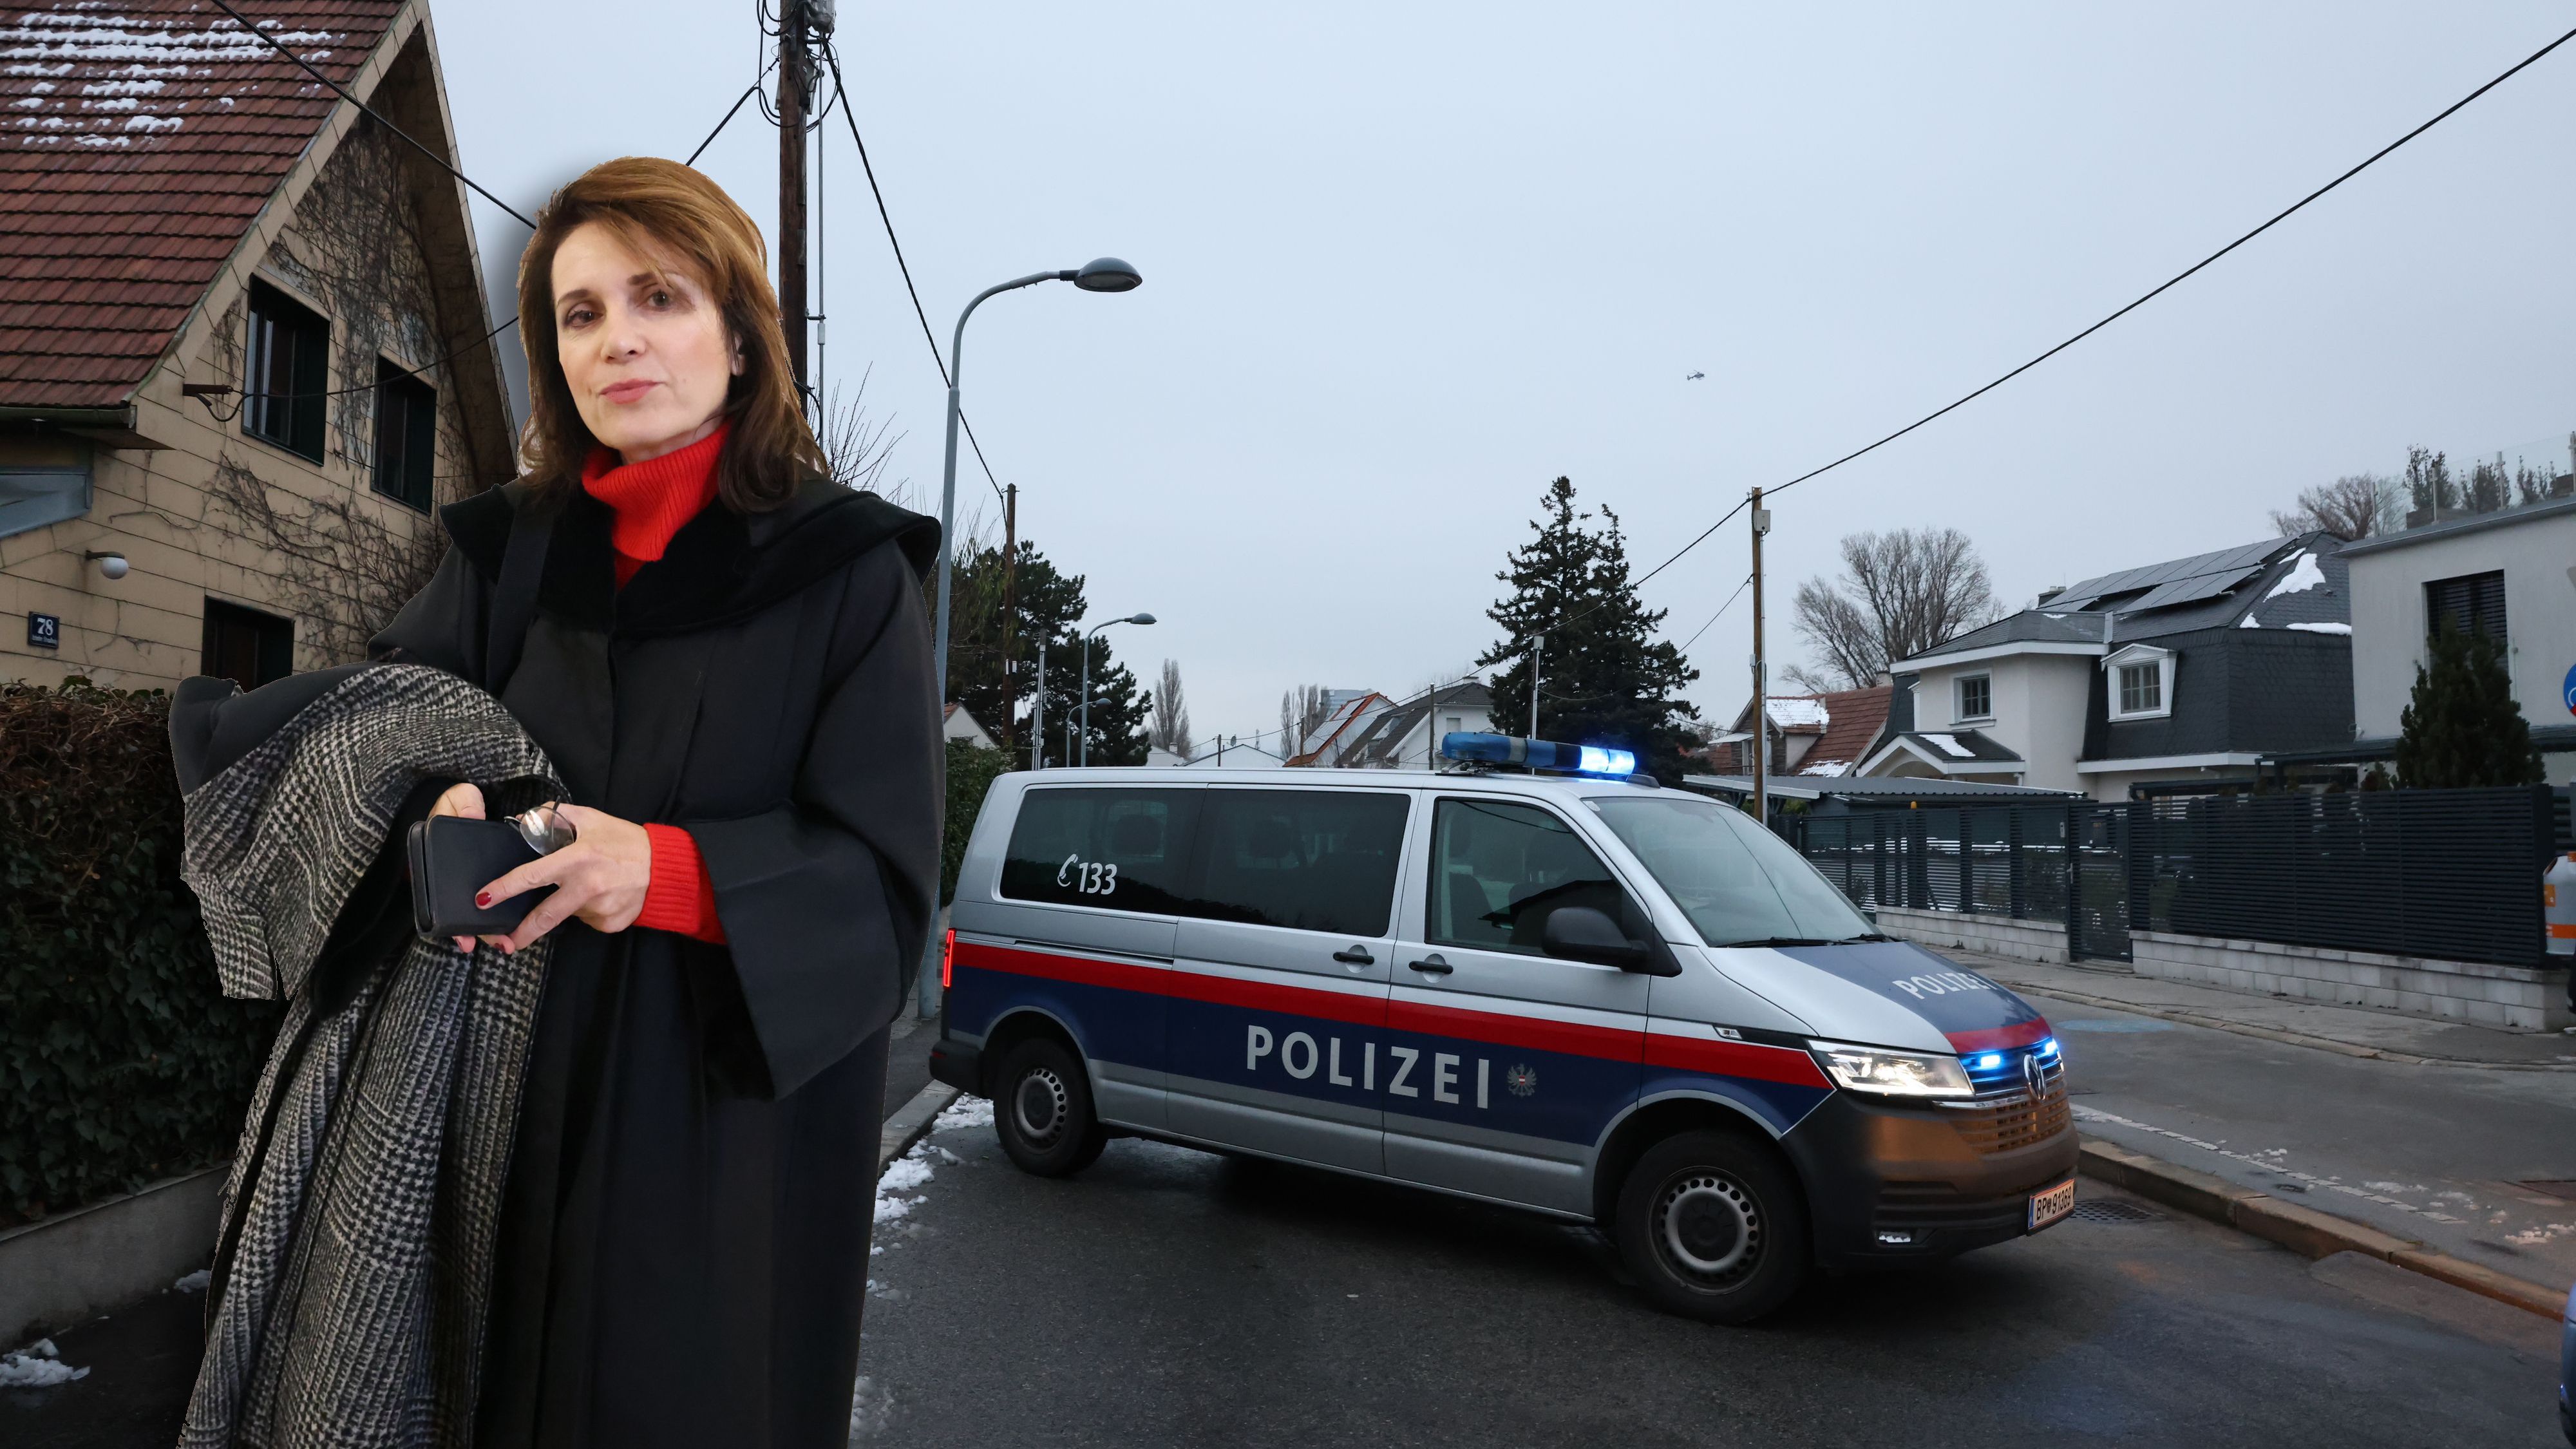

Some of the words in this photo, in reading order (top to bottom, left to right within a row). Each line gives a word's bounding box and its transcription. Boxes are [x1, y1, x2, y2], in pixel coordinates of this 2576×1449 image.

[37, 618, 53, 636] 78
[1079, 862, 1117, 895] 133
[1892, 972, 1998, 999] POLIZEI
[1247, 1025, 1489, 1109] POLIZEI
[2037, 1197, 2047, 1220] BP
